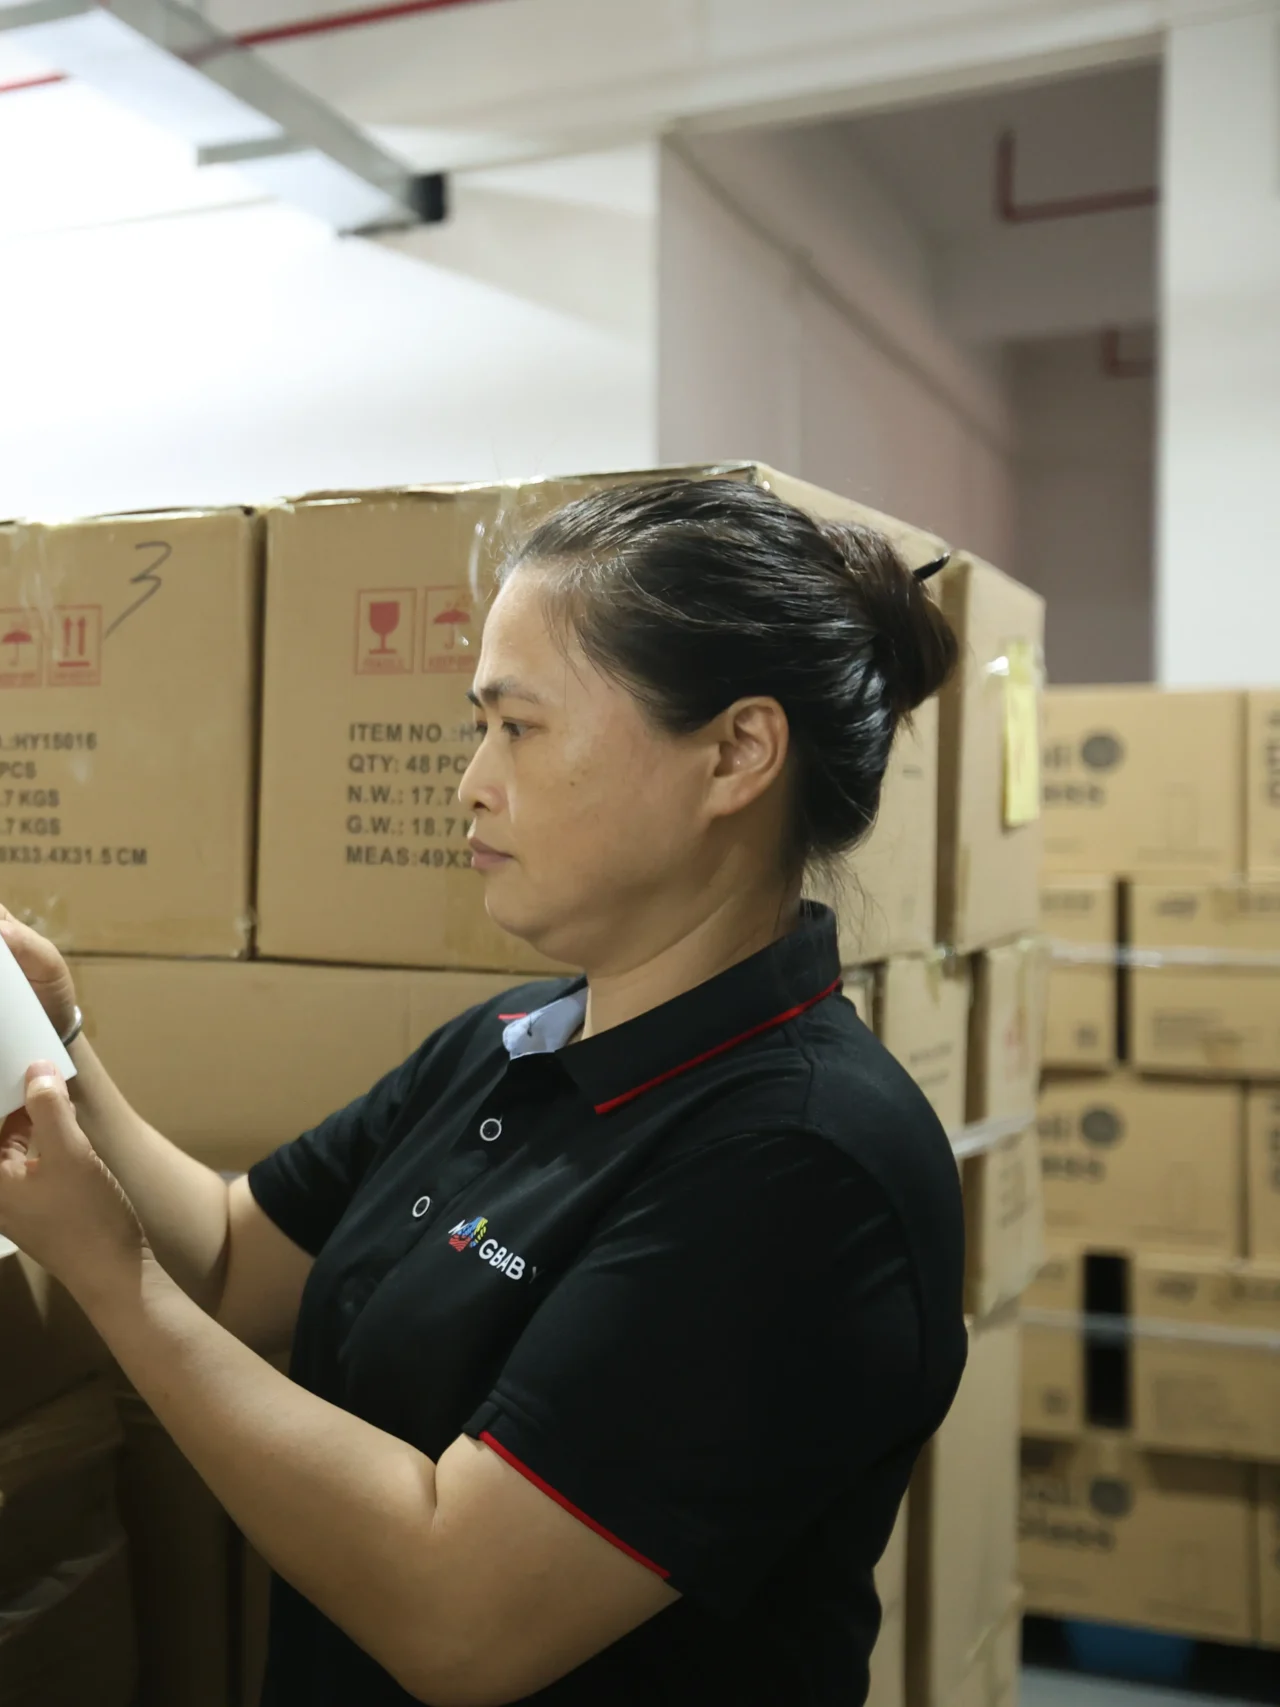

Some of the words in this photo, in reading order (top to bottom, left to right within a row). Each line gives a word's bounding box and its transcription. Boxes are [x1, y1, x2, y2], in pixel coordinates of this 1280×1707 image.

[106, 541, 172, 637] 3
[349, 722, 403, 743] ITEM
[348, 753, 400, 774] QTY:
[406, 754, 431, 774] 48
[437, 755, 471, 775] PC
[19, 789, 60, 807] KGS
[347, 785, 404, 804] N.W.:
[411, 785, 456, 806] 17.7
[20, 817, 61, 836] KGS
[346, 815, 405, 836] G.W.:
[411, 816, 456, 837] 18.7
[116, 848, 148, 865] CM
